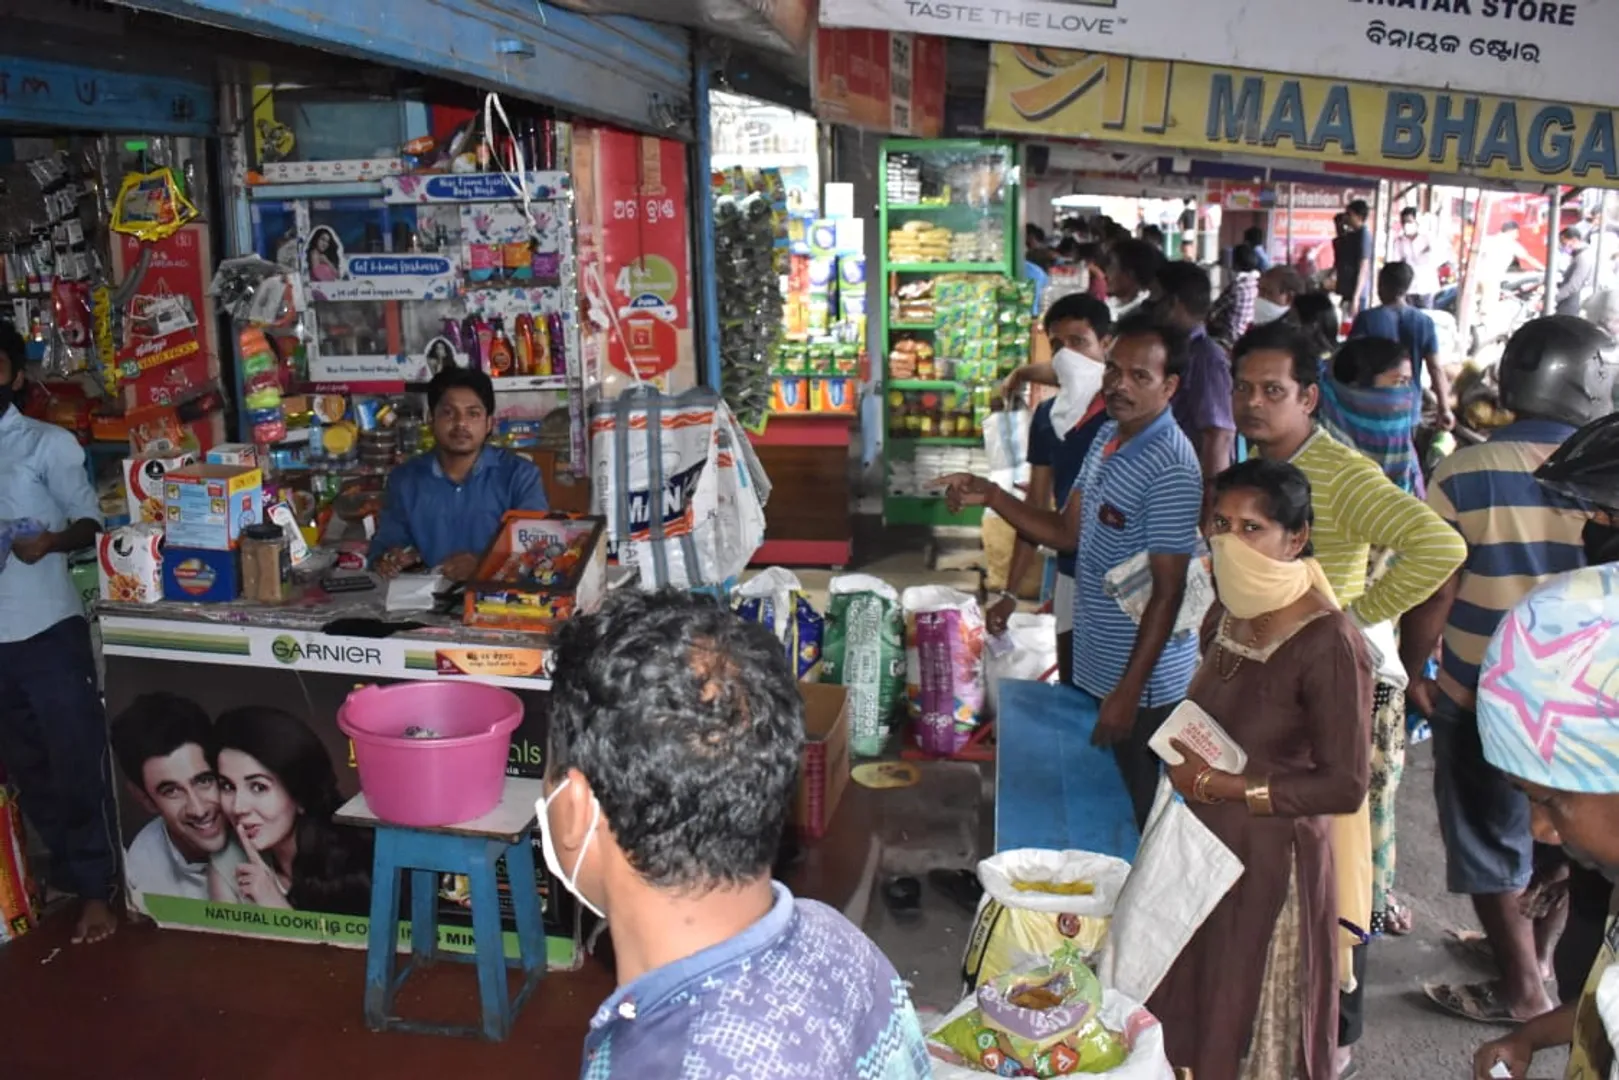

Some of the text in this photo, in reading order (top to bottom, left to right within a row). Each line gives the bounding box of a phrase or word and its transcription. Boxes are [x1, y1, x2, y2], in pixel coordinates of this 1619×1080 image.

[905, 1, 985, 22] TASTE
[991, 8, 1040, 28] THE
[1480, 0, 1577, 26] STORE
[1366, 19, 1460, 54] ବିନାୟକ
[1205, 72, 1357, 155] MAA
[508, 739, 542, 764] als
[205, 907, 269, 926] NATURAL
[345, 923, 369, 937] CO
